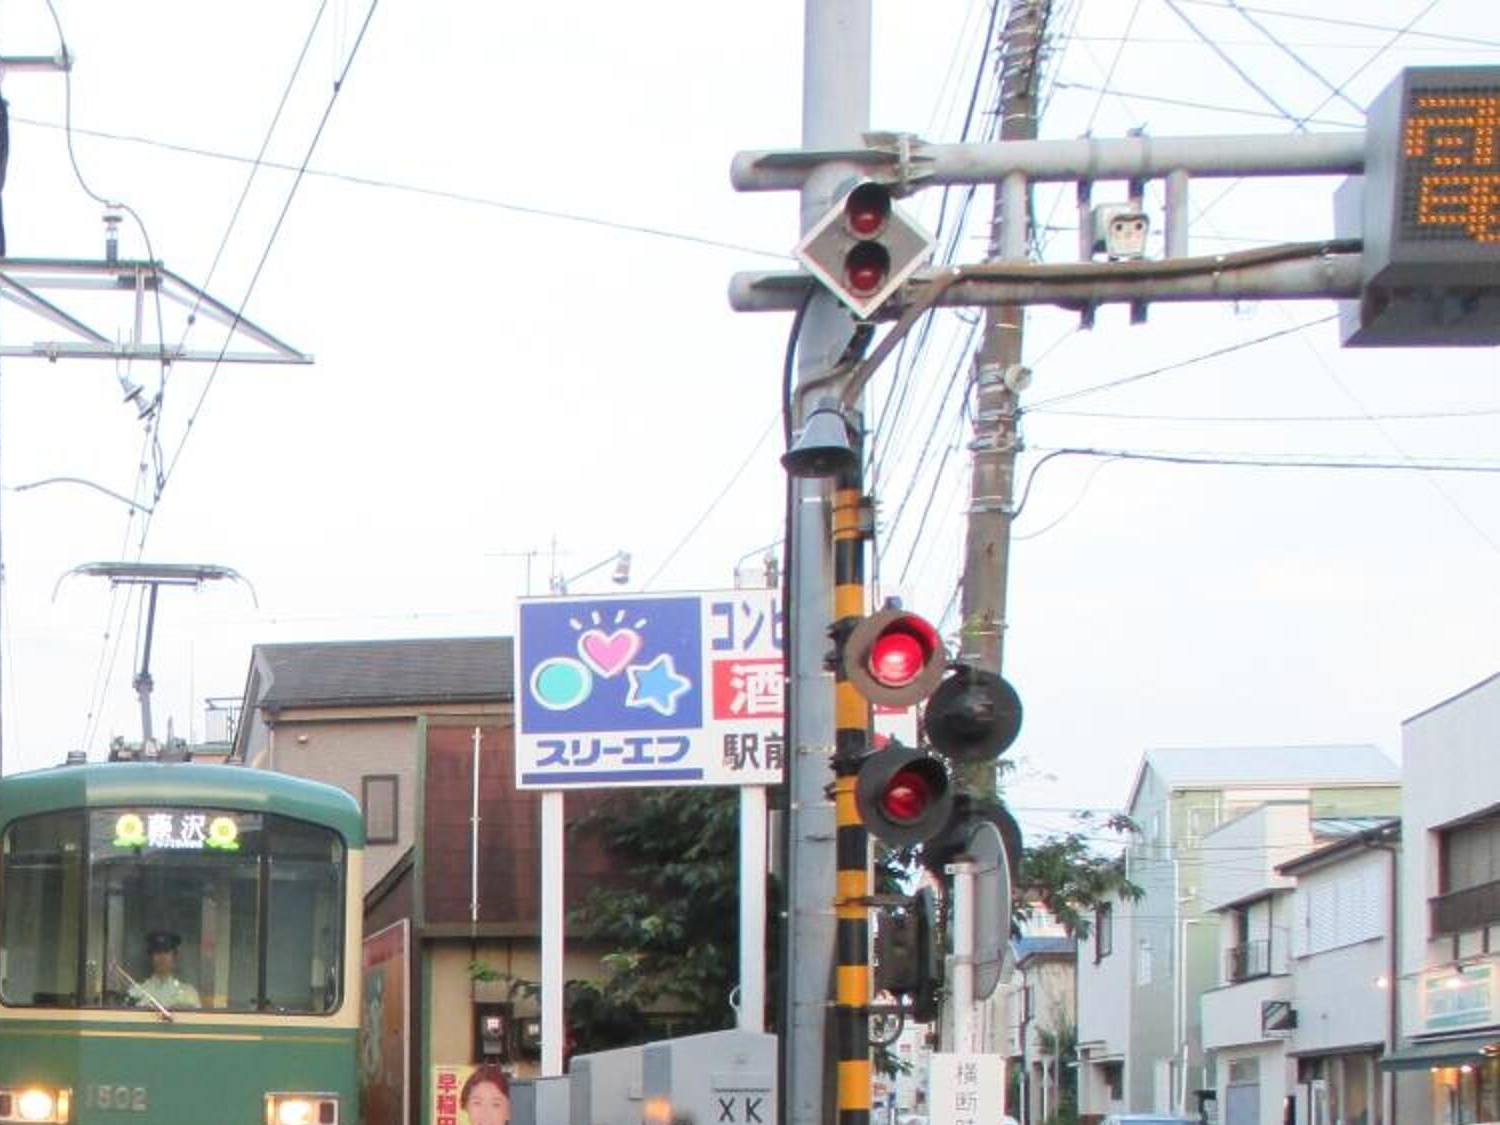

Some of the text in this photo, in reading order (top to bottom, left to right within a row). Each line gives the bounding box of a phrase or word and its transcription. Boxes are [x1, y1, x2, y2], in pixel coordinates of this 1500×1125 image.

[729, 662, 784, 715] 酒
[536, 735, 692, 767] スリーエフ
